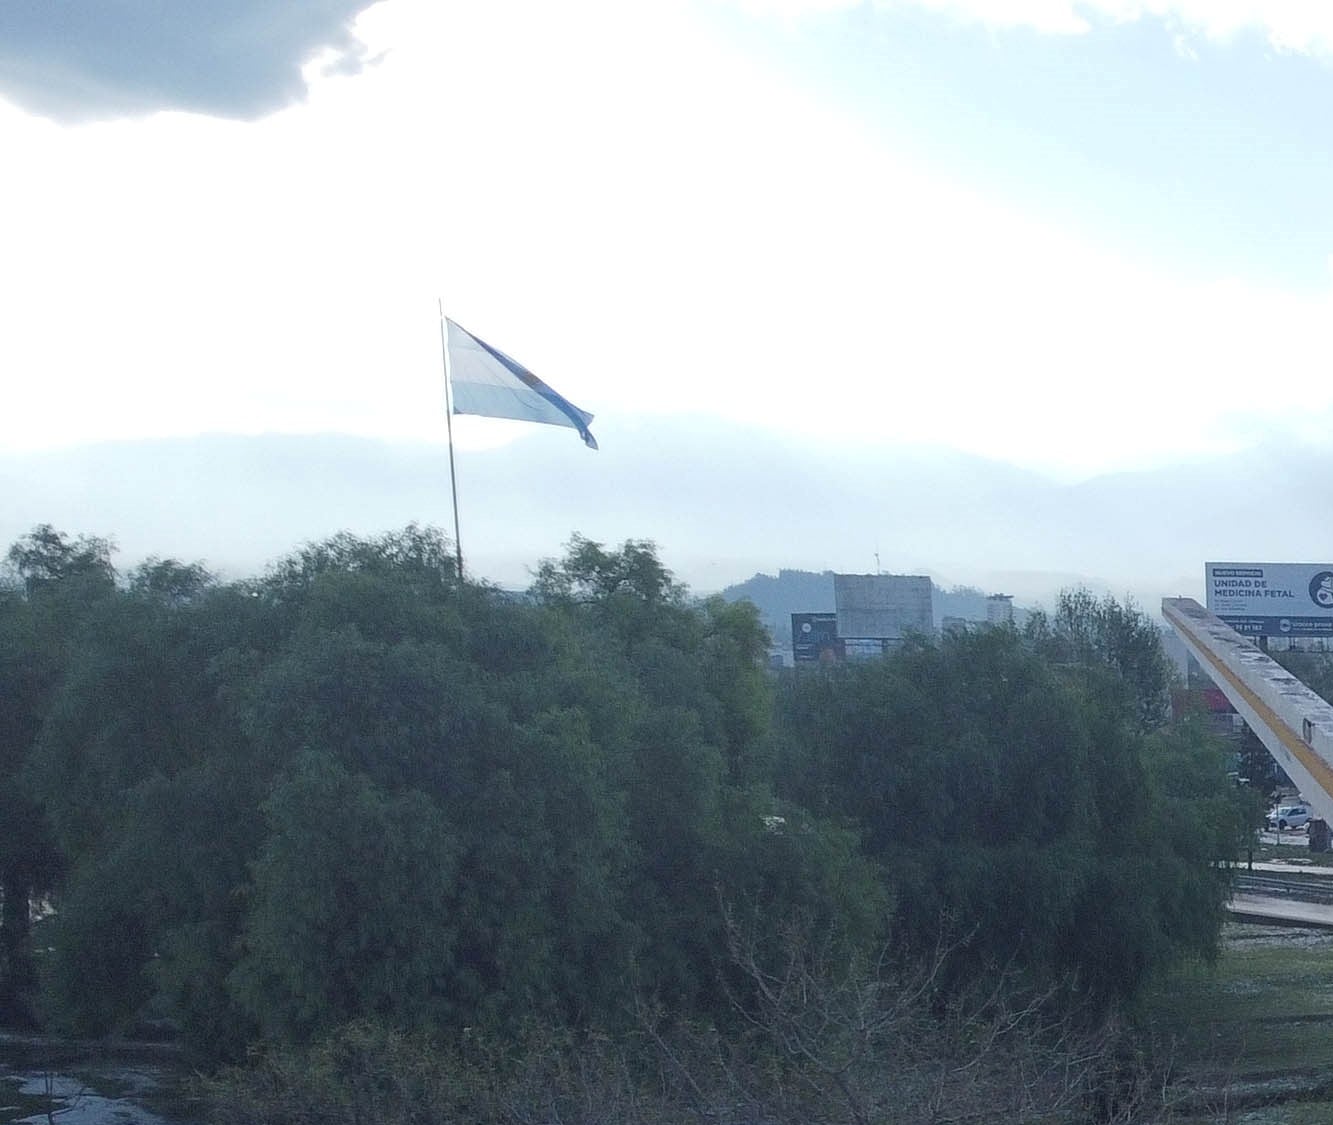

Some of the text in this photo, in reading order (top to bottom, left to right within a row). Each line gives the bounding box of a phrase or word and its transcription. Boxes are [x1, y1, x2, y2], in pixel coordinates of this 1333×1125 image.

[1214, 580, 1268, 588] UNIDAD DE
[1214, 589, 1296, 598] MEDICINA FETAL
